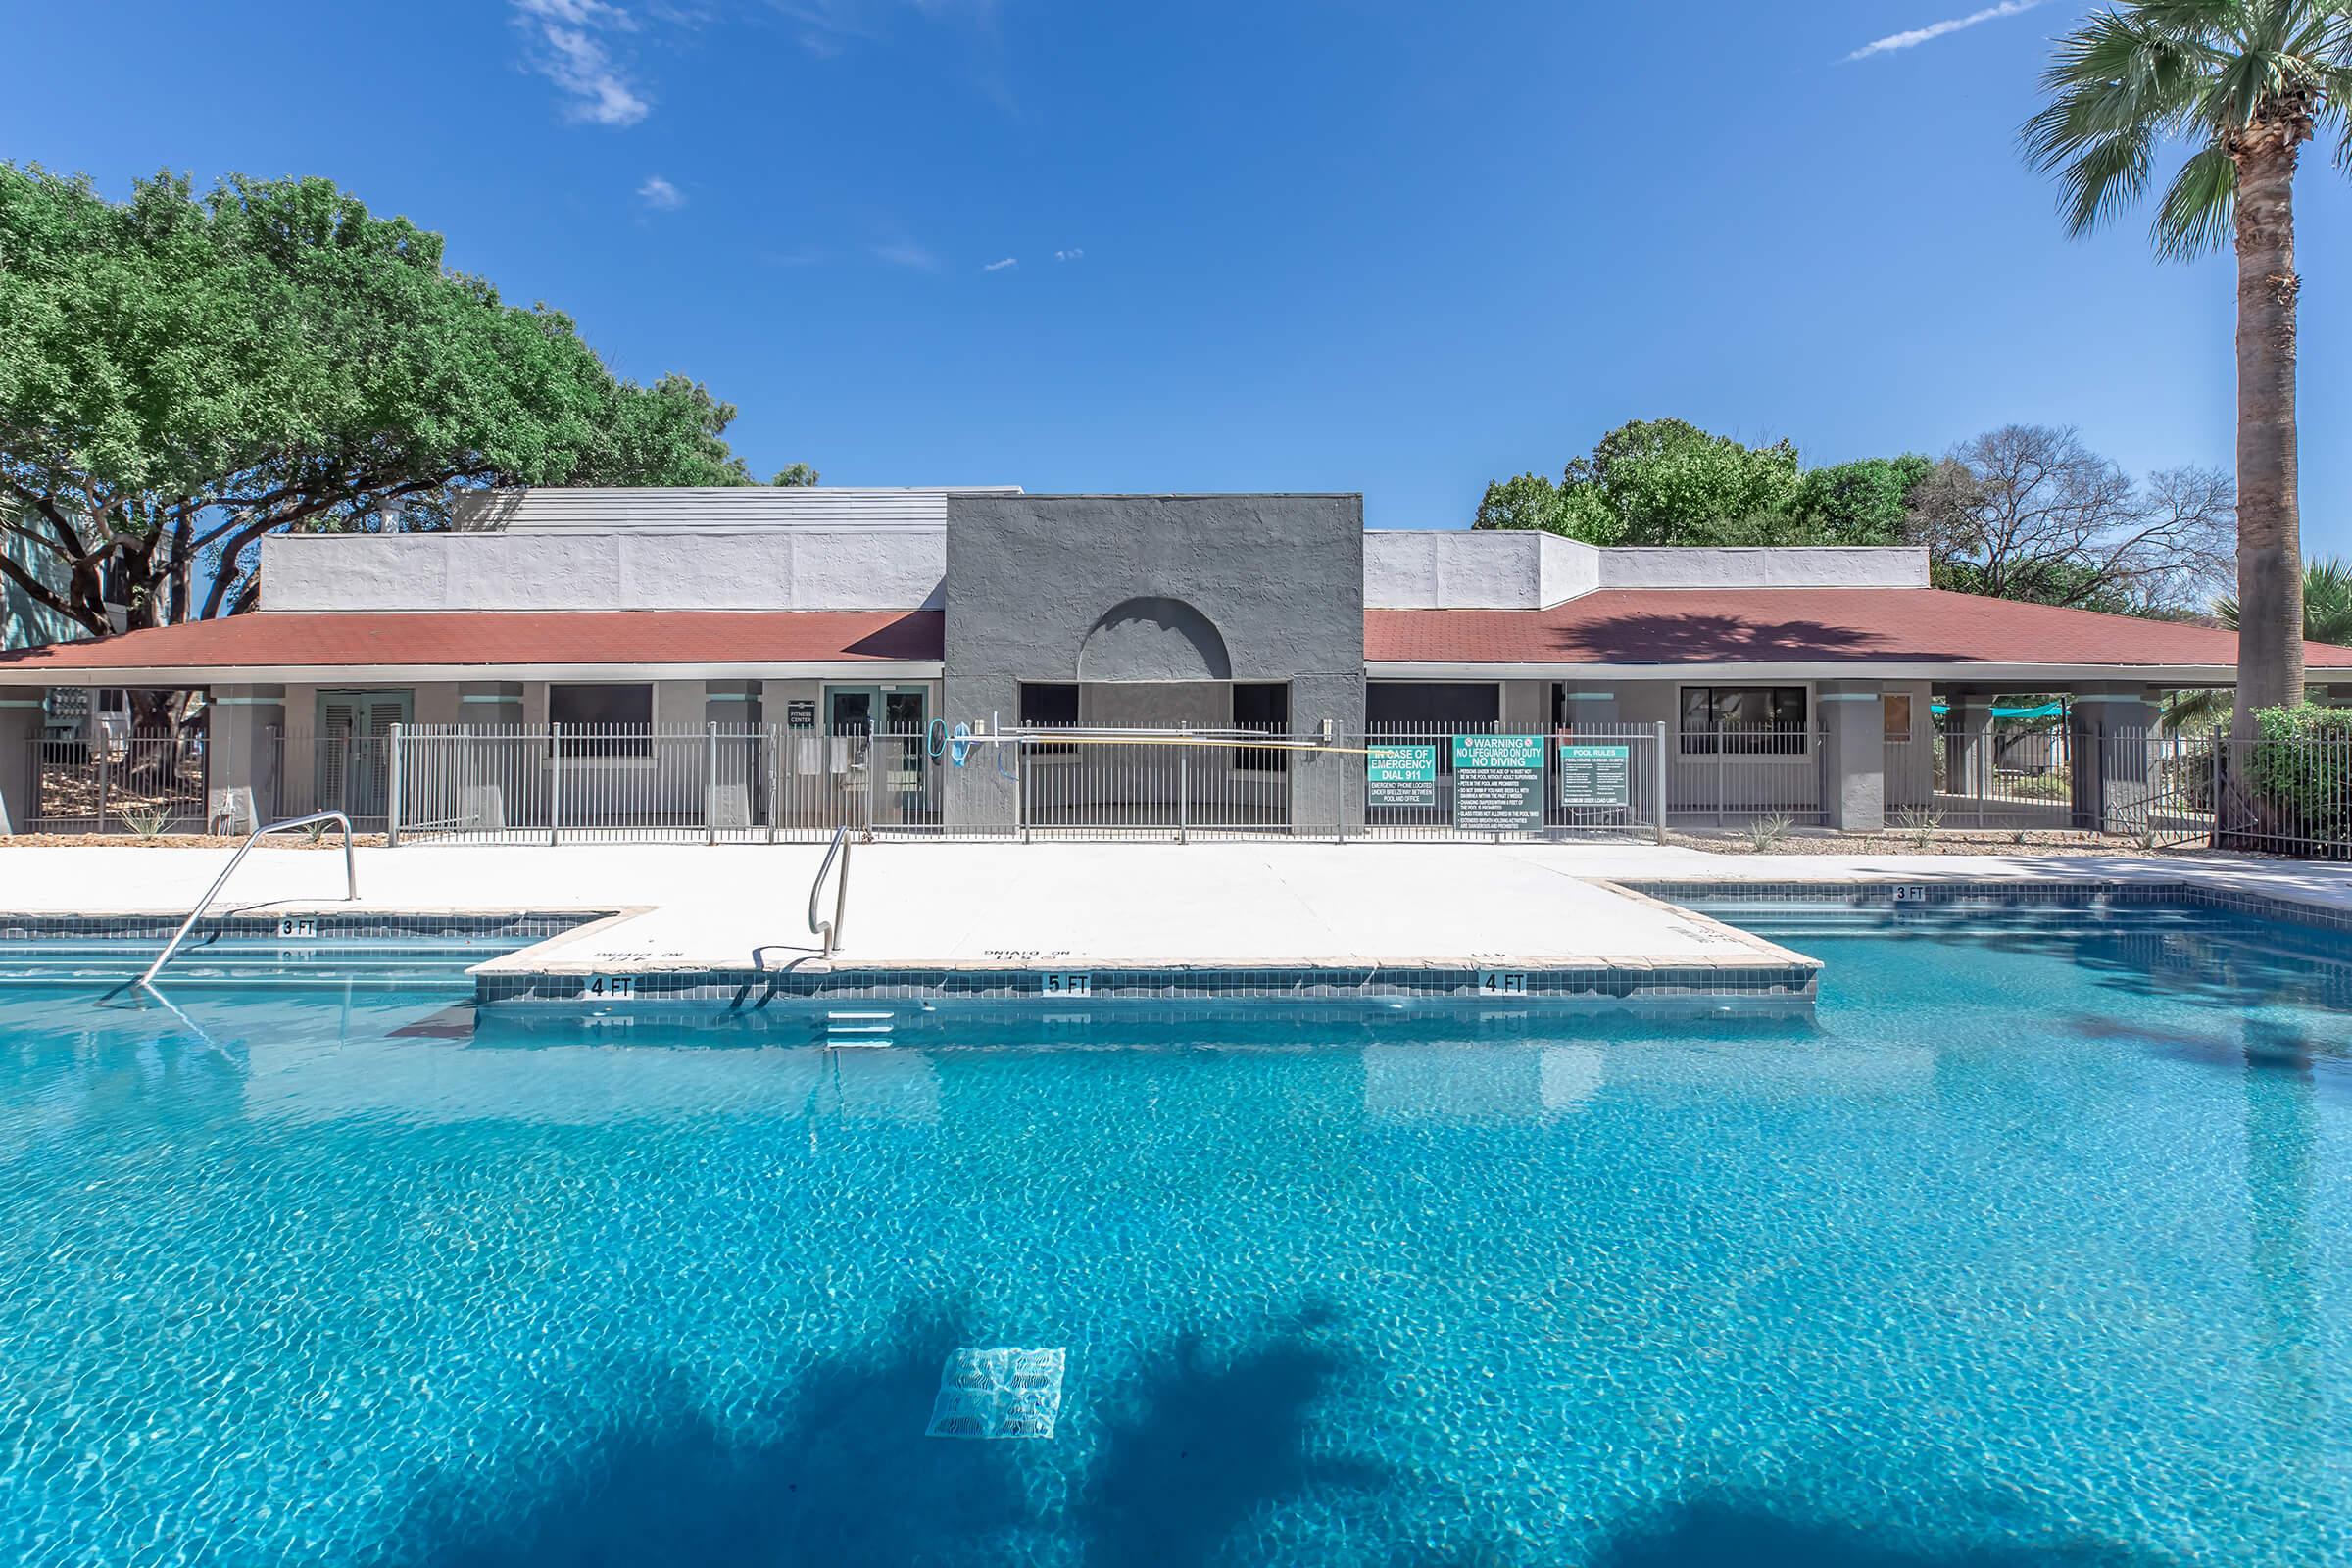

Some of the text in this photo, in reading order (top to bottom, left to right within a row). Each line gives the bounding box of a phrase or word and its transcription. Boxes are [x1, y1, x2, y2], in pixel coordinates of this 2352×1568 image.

[1473, 739, 1523, 748] WARNING
[1387, 749, 1413, 759] CASE
[1415, 749, 1428, 759] OF
[1457, 748, 1541, 757] NO LIFEGUARD ON DUTY
[1372, 760, 1432, 769] EMERGENCY
[1472, 757, 1525, 767] NO DIVING
[1382, 770, 1421, 780] DIAL 911
[1897, 887, 1923, 899] 3 FT
[284, 921, 314, 934] 3 FT
[591, 978, 631, 996] 4 FT
[1049, 975, 1088, 994] 5 FT
[1485, 974, 1524, 992] 4 FT
